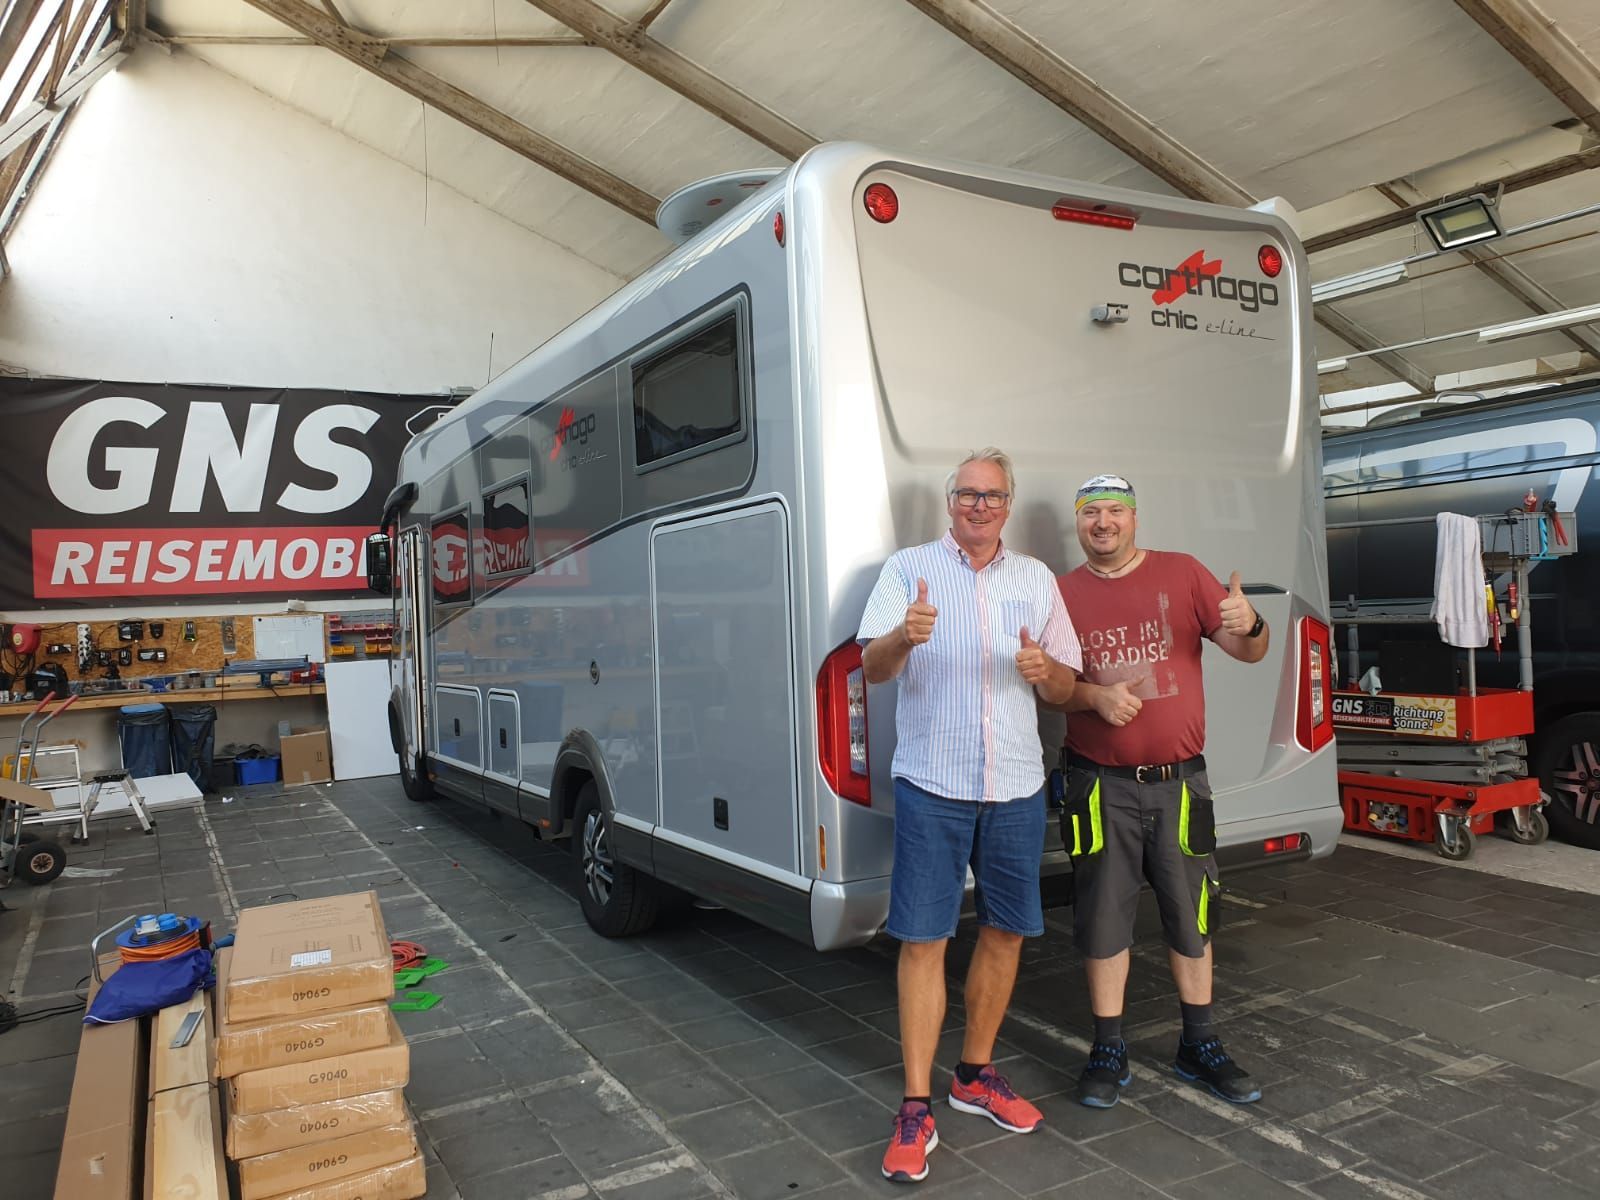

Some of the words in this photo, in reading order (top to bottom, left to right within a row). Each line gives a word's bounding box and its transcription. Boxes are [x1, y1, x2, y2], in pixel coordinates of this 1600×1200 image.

[1118, 262, 1279, 313] carthago
[1151, 308, 1198, 331] chic
[46, 396, 381, 515] GNS
[1139, 619, 1159, 642] IN
[1332, 698, 1364, 714] GNS
[1393, 705, 1445, 722] Richtung
[1393, 716, 1434, 730] Sonne!
[292, 987, 331, 1002] G9040
[285, 1037, 325, 1053] G9040
[308, 1069, 348, 1084] G9040
[299, 1117, 339, 1134] G9040
[308, 1154, 348, 1173] G9040
